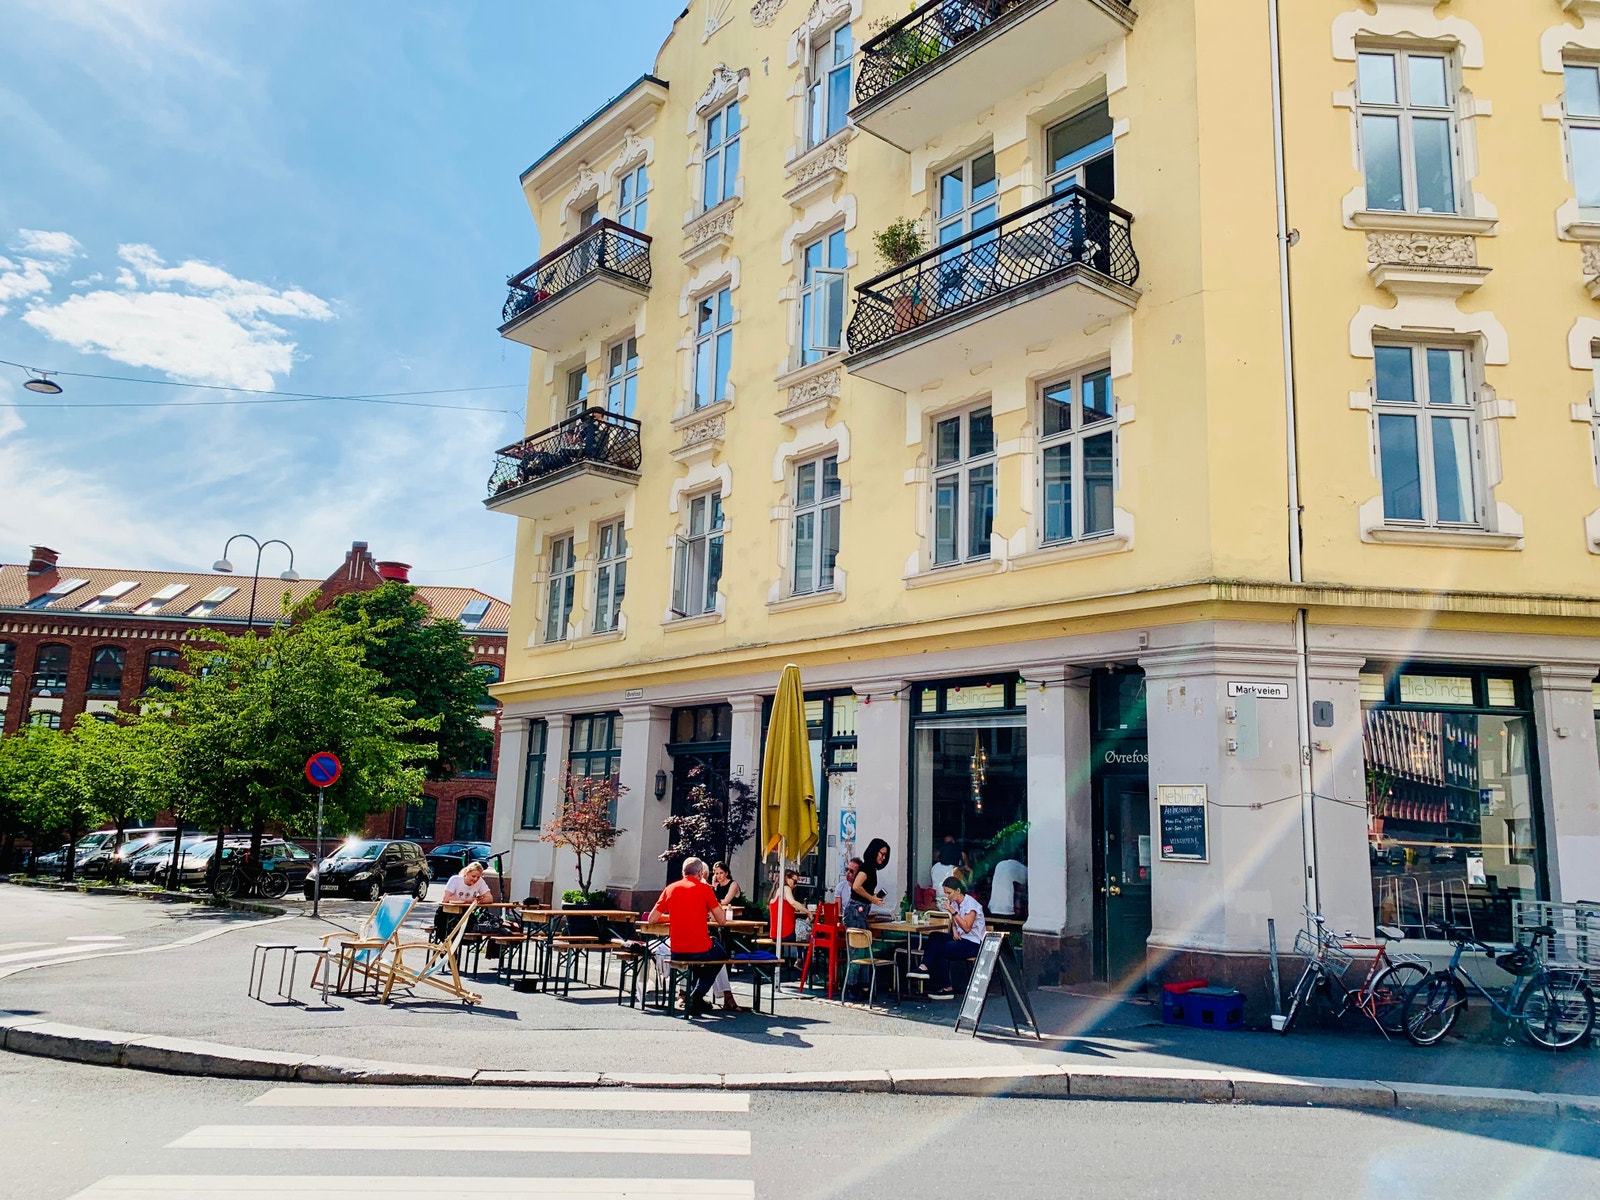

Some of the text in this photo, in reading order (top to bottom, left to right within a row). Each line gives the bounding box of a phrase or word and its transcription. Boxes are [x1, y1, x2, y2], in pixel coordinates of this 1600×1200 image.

[1235, 685, 1281, 695] Markveien
[1407, 676, 1461, 703] liebling
[951, 689, 986, 707] liebling
[1104, 749, 1149, 764] Øvrefos
[1162, 788, 1203, 804] liebling
